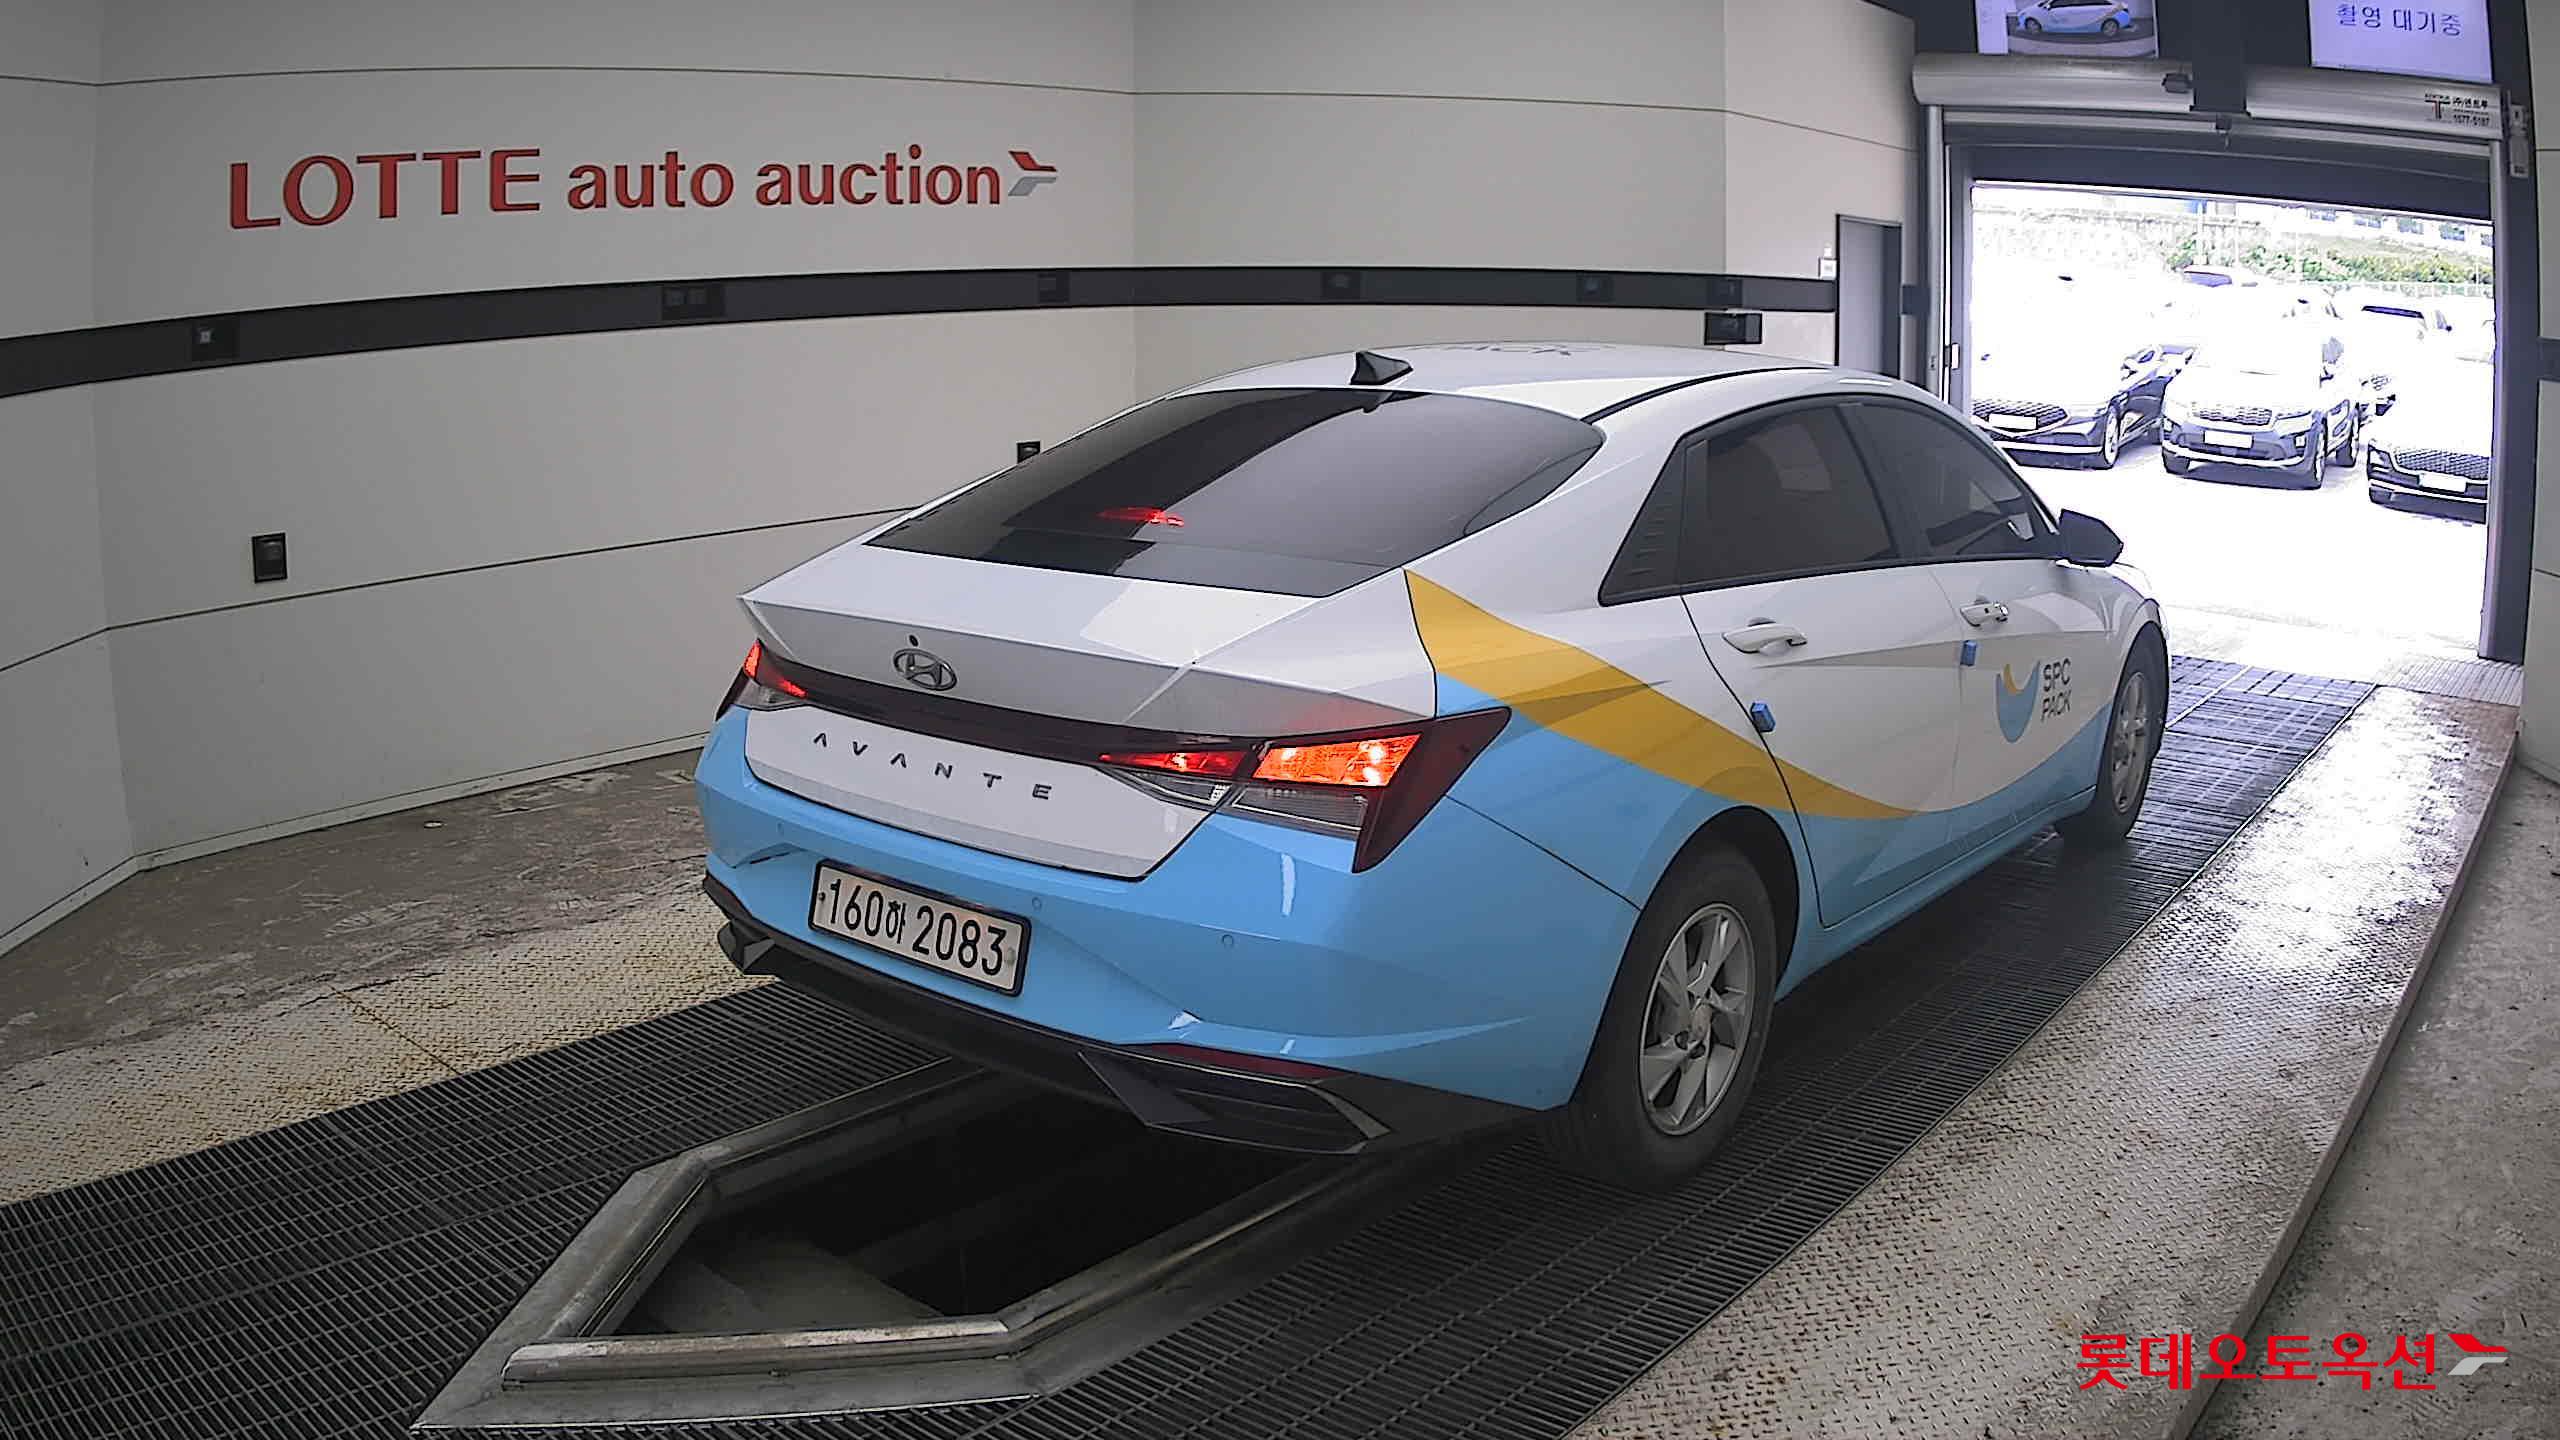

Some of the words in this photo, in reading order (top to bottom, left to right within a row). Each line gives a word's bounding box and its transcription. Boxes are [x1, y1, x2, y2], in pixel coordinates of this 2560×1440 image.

[2393, 9, 2461, 36] 대기중
[229, 148, 541, 229] LOTTE
[567, 151, 735, 209] auto
[755, 144, 1001, 206] auction
[2042, 657, 2071, 692] SPC
[2041, 690, 2071, 722] PACK
[813, 733, 1052, 800] AVANTE
